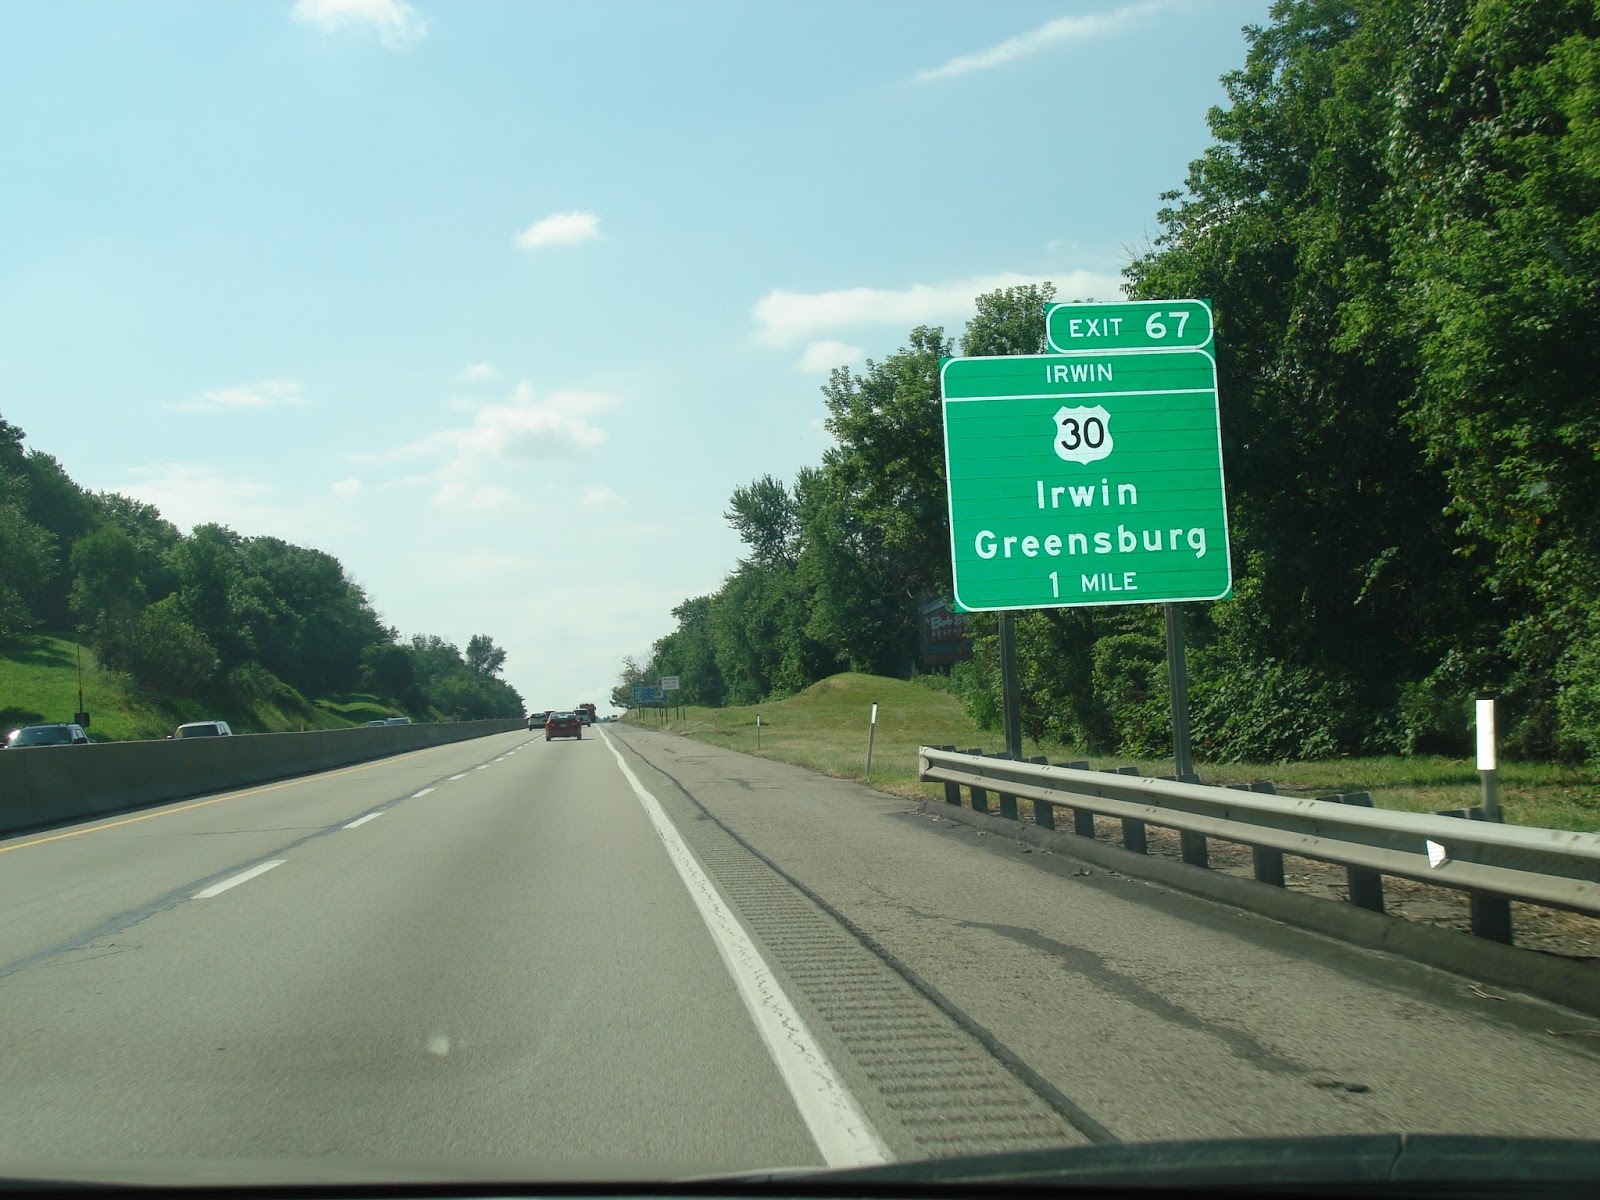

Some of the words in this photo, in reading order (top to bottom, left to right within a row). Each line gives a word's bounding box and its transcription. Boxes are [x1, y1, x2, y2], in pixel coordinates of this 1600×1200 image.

[1069, 317, 1123, 338] EXIT
[1145, 311, 1190, 339] 67
[1046, 363, 1113, 384] IRWIN
[1061, 417, 1105, 450] 30
[1036, 477, 1138, 509] Irwin
[974, 524, 1207, 559] Greensburg
[1048, 571, 1059, 598] 1
[1081, 571, 1138, 593] MILE
[930, 616, 953, 630] Bob
